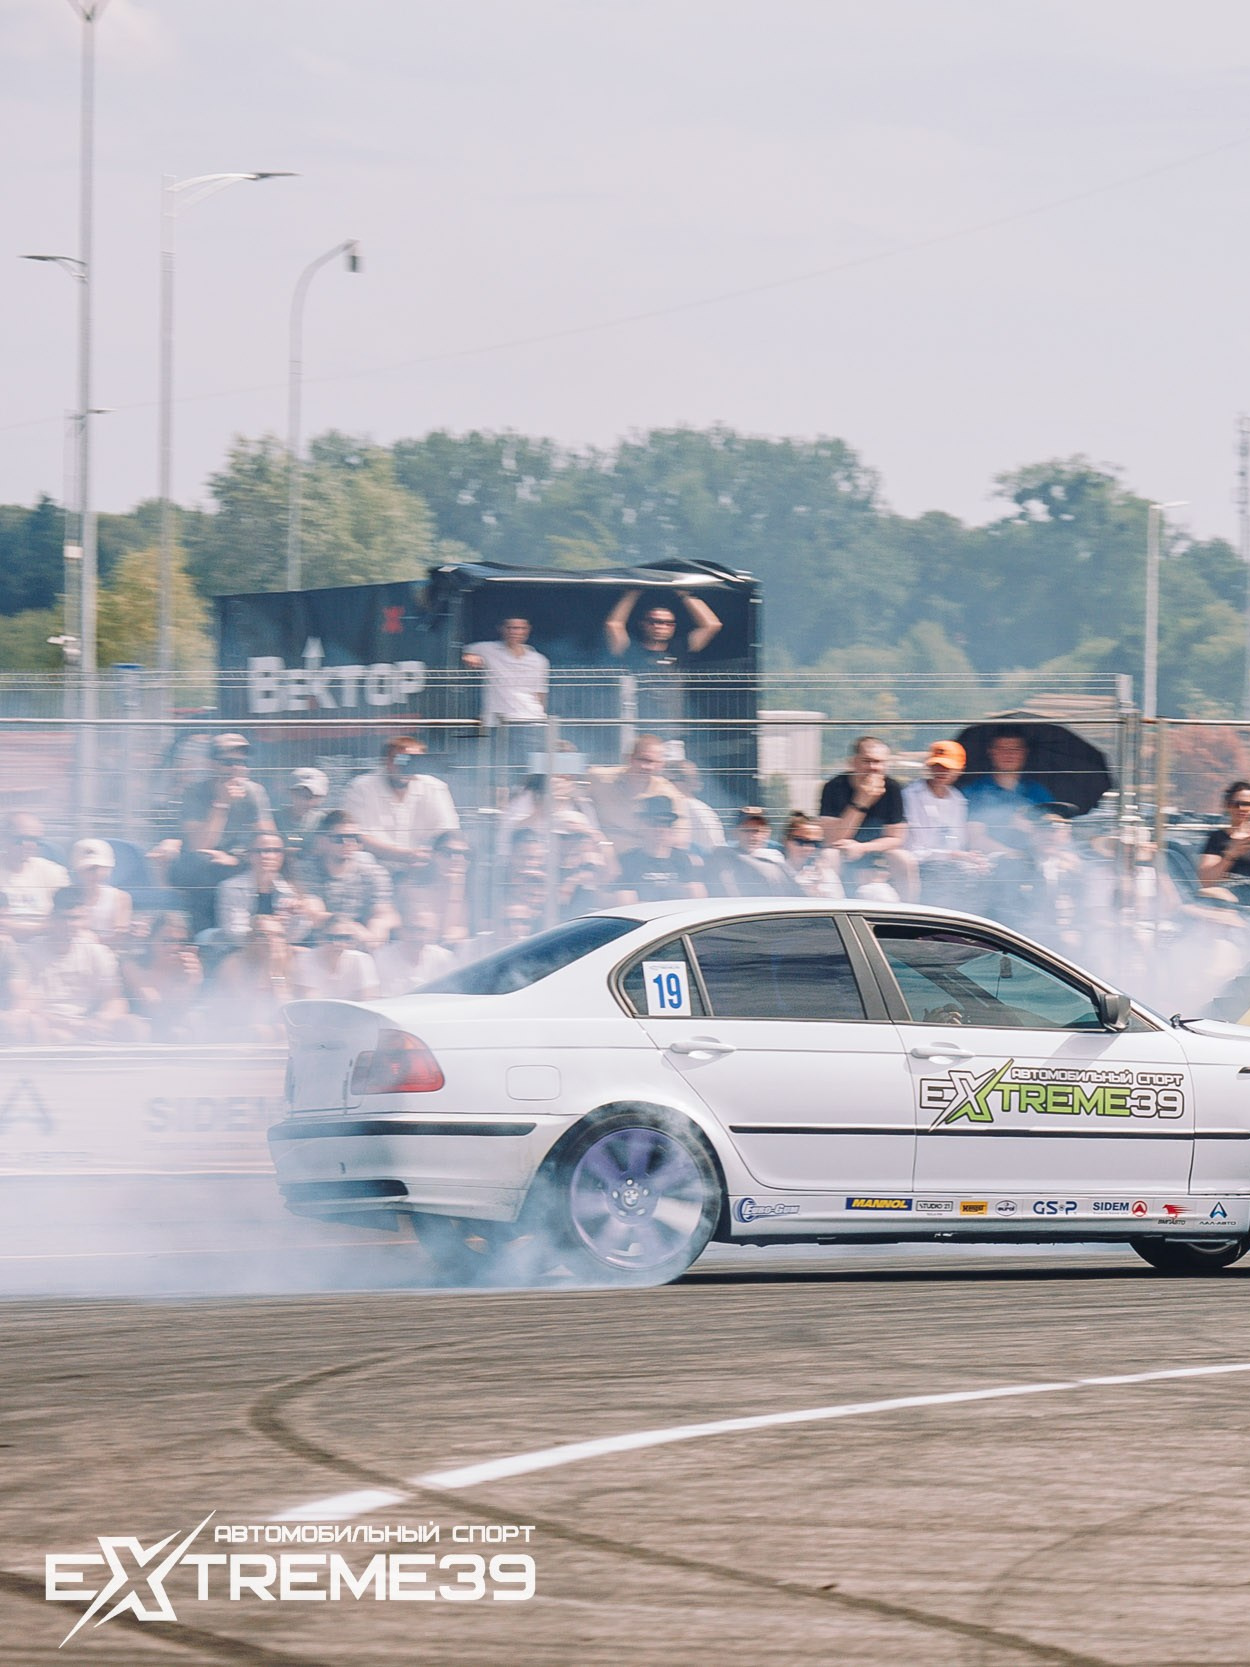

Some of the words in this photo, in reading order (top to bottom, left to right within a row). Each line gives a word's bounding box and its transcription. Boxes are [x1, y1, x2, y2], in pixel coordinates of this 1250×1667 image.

[653, 973, 682, 1009] 19
[1011, 1067, 1133, 1084] АВТОМОБИЛЬНЫЙ
[1137, 1072, 1184, 1086] СПОРТ
[852, 1199, 909, 1209] MANNOL
[1093, 1201, 1130, 1211] SIDEM
